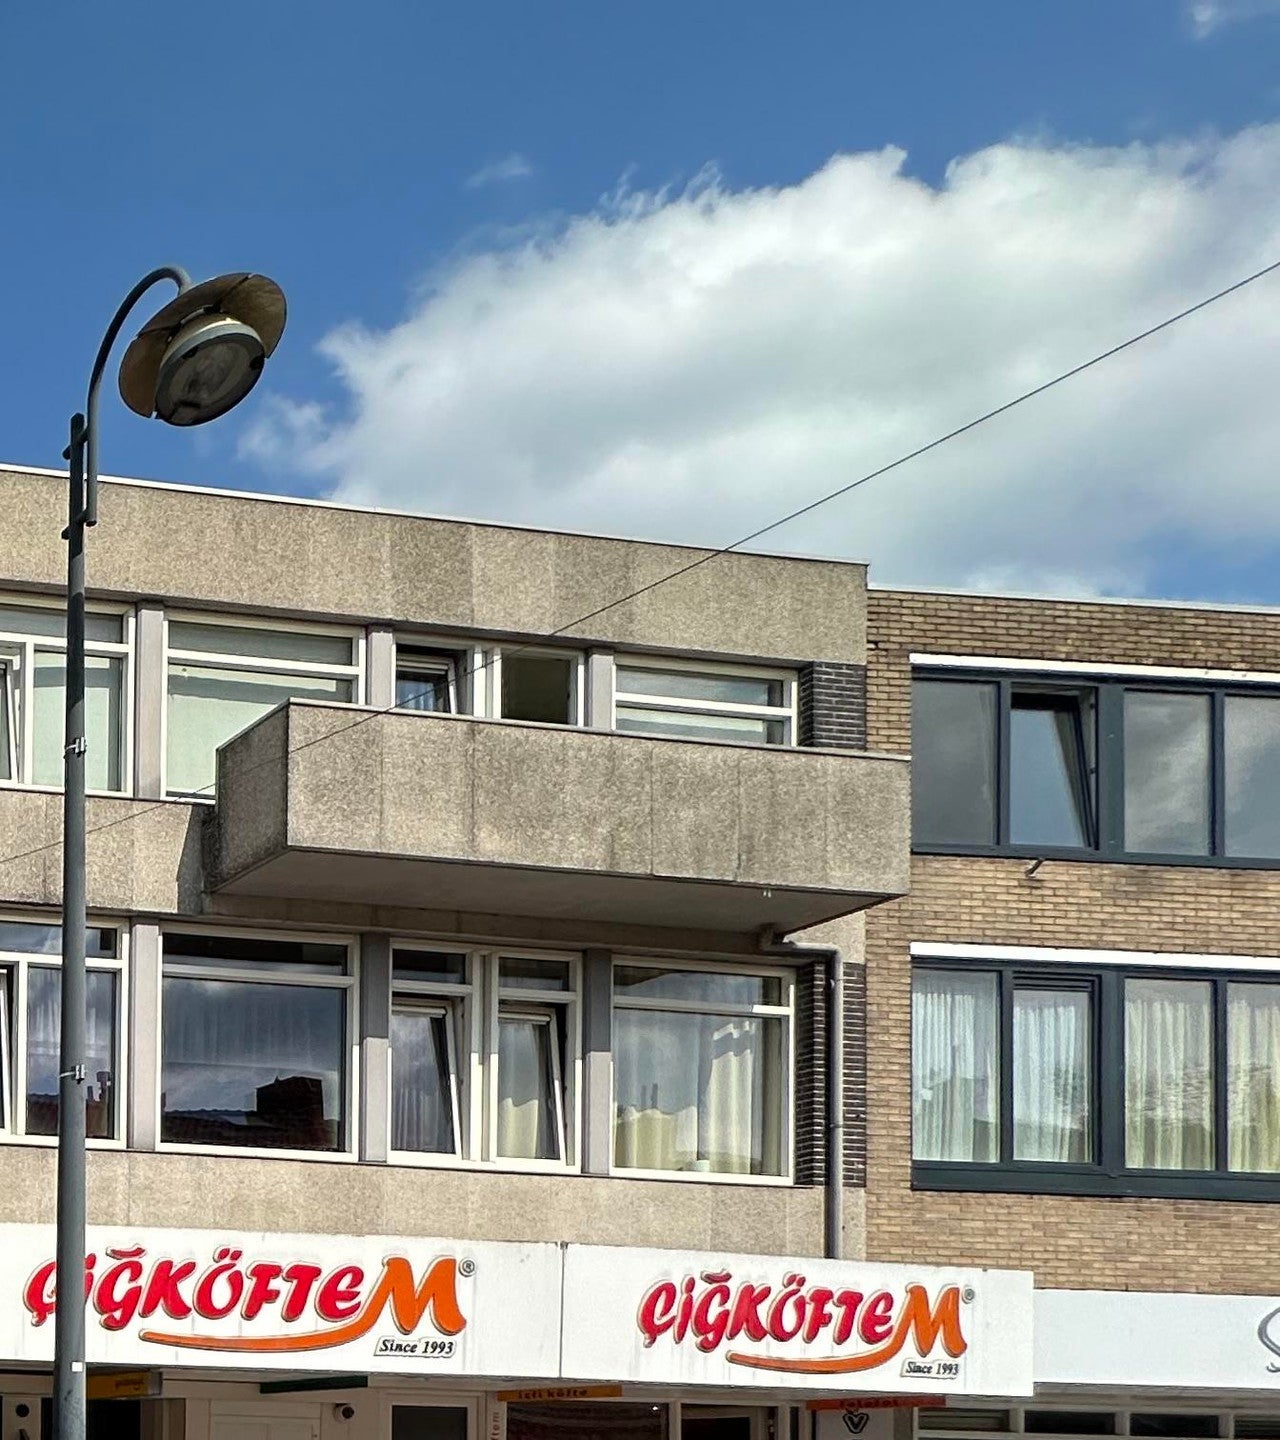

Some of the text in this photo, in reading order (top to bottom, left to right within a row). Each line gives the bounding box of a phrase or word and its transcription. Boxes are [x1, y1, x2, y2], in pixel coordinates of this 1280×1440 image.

[379, 1339, 454, 1356] Since 1993
[905, 1361, 959, 1377] Since 1993
